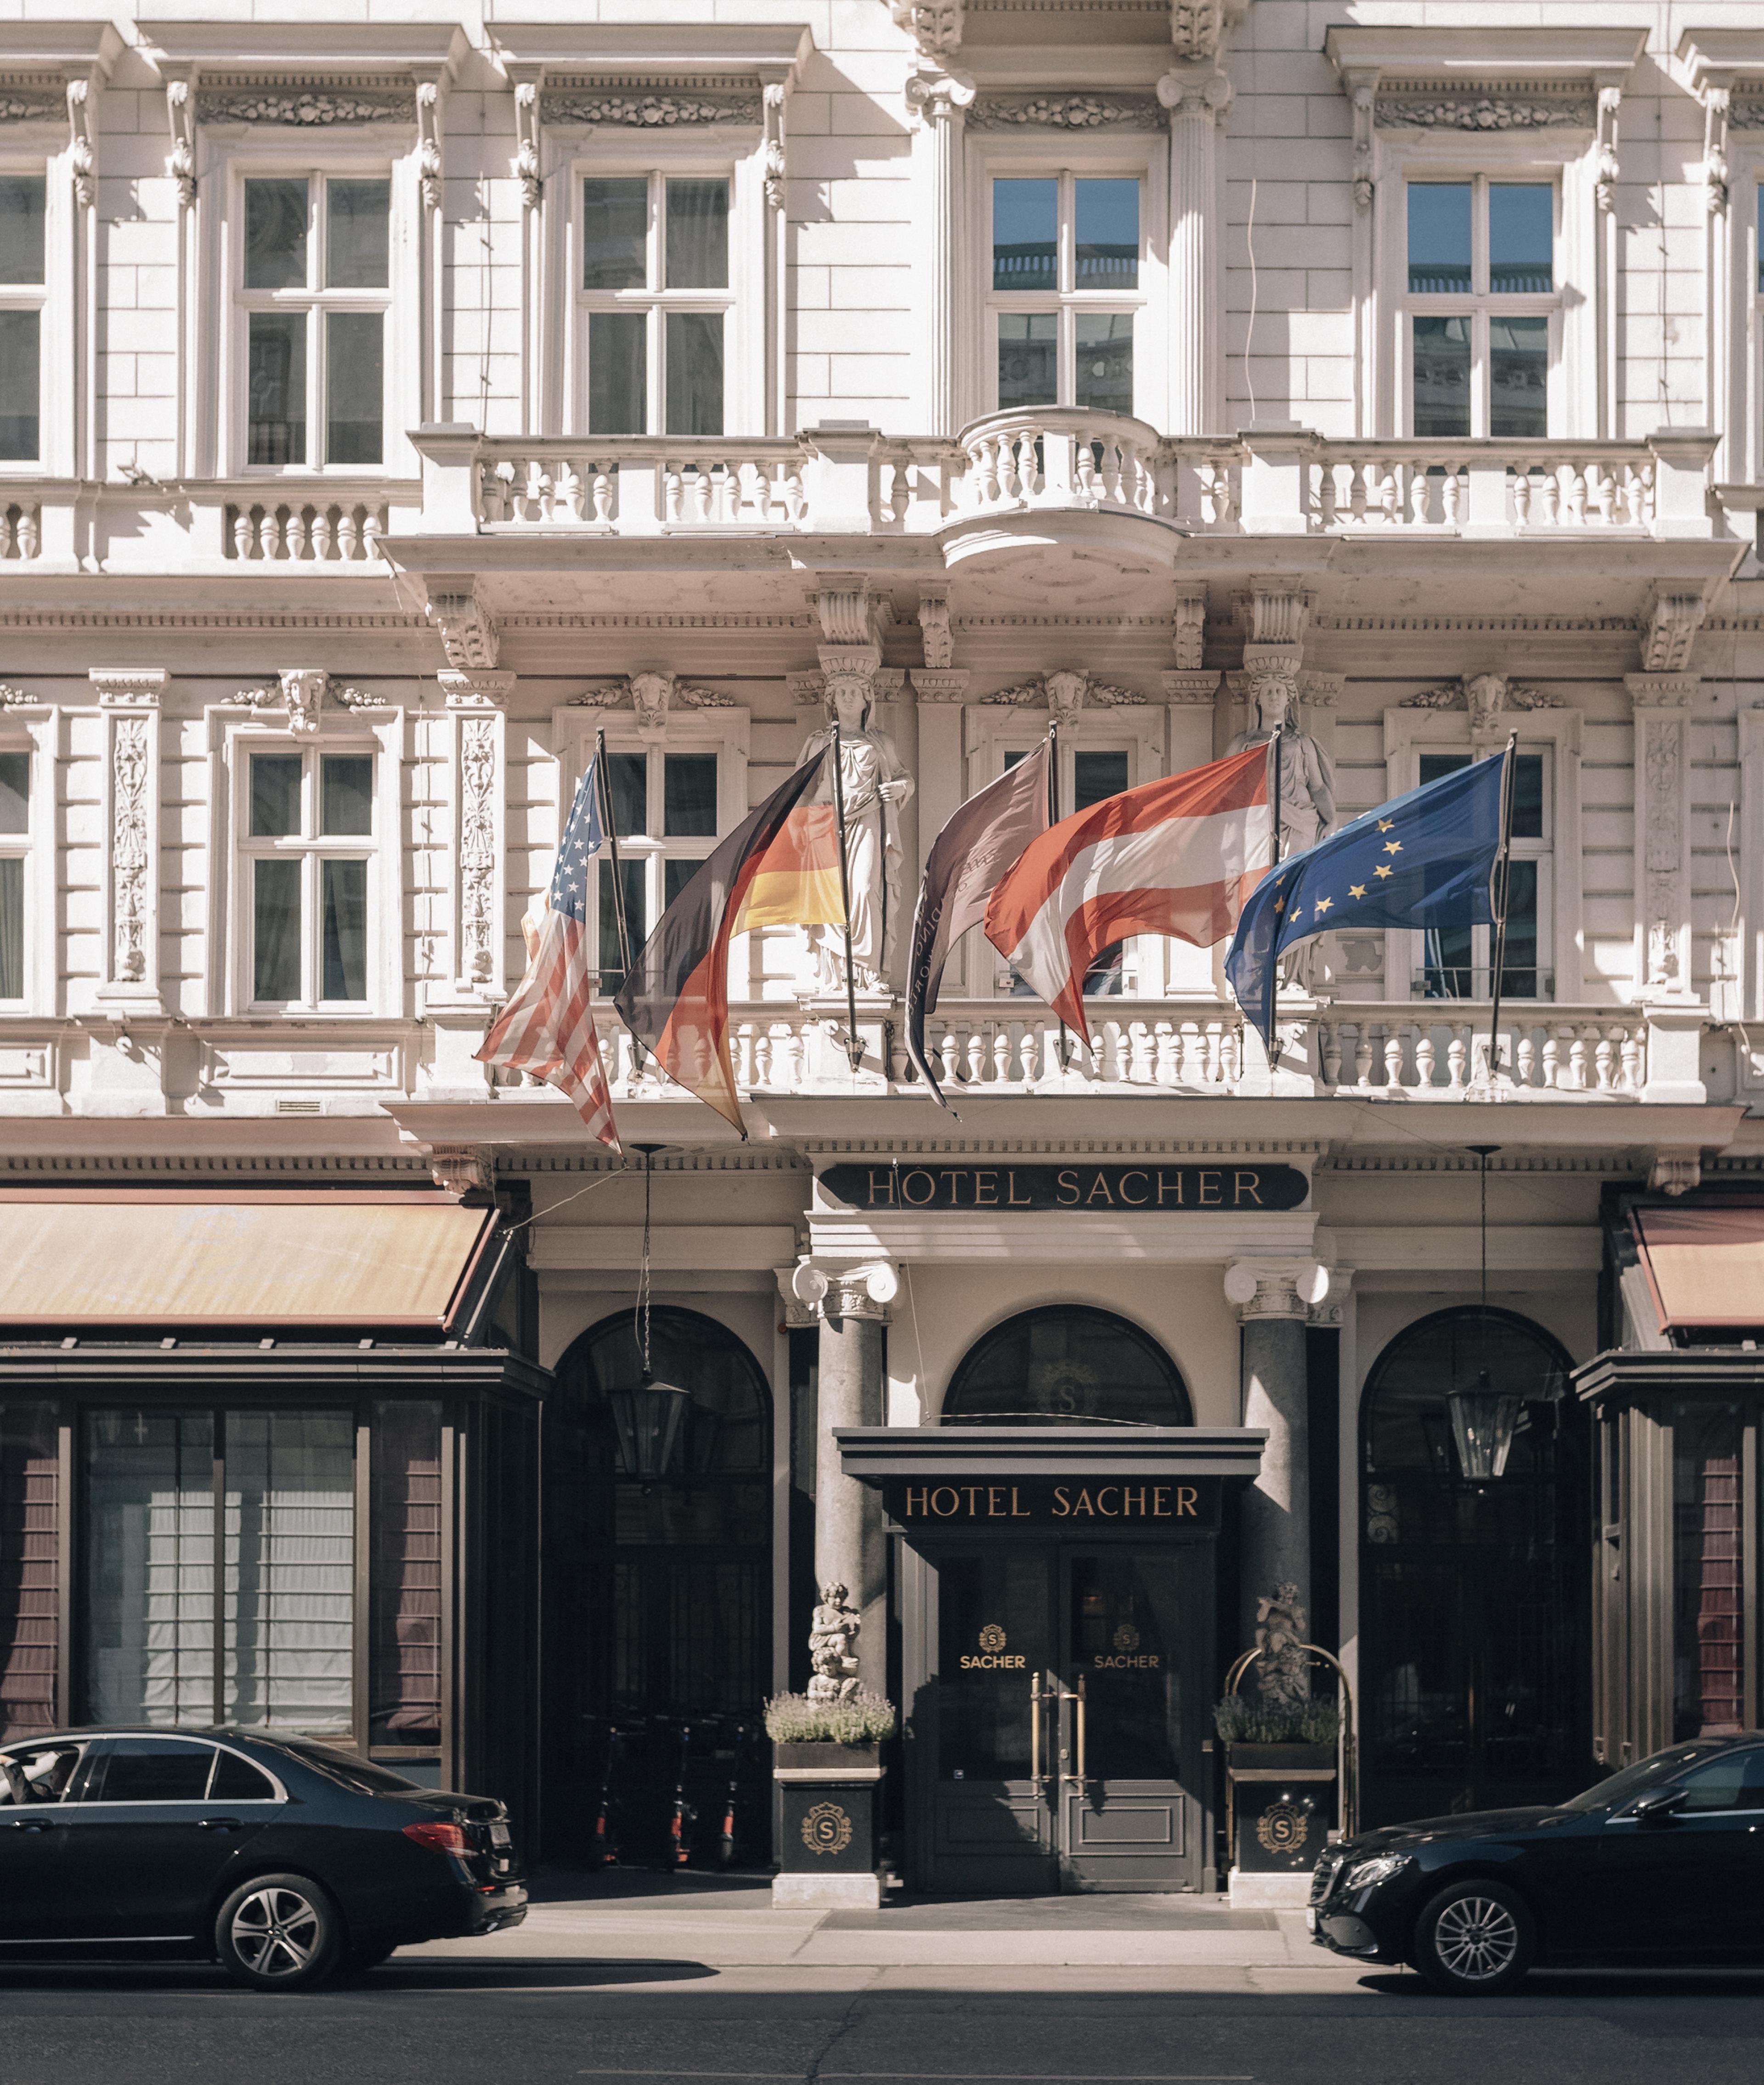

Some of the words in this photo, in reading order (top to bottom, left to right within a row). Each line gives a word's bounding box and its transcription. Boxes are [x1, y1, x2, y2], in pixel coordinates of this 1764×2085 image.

[1057, 1170, 1264, 1204] SACHER
[906, 1487, 1031, 1516] HOTEL
[1052, 1486, 1198, 1516] SACHER
[988, 1634, 997, 1645] S
[960, 1655, 1026, 1669] SACHER
[1094, 1655, 1159, 1668] SACHER
[819, 1821, 834, 1840] S
[1275, 1820, 1290, 1838] S
